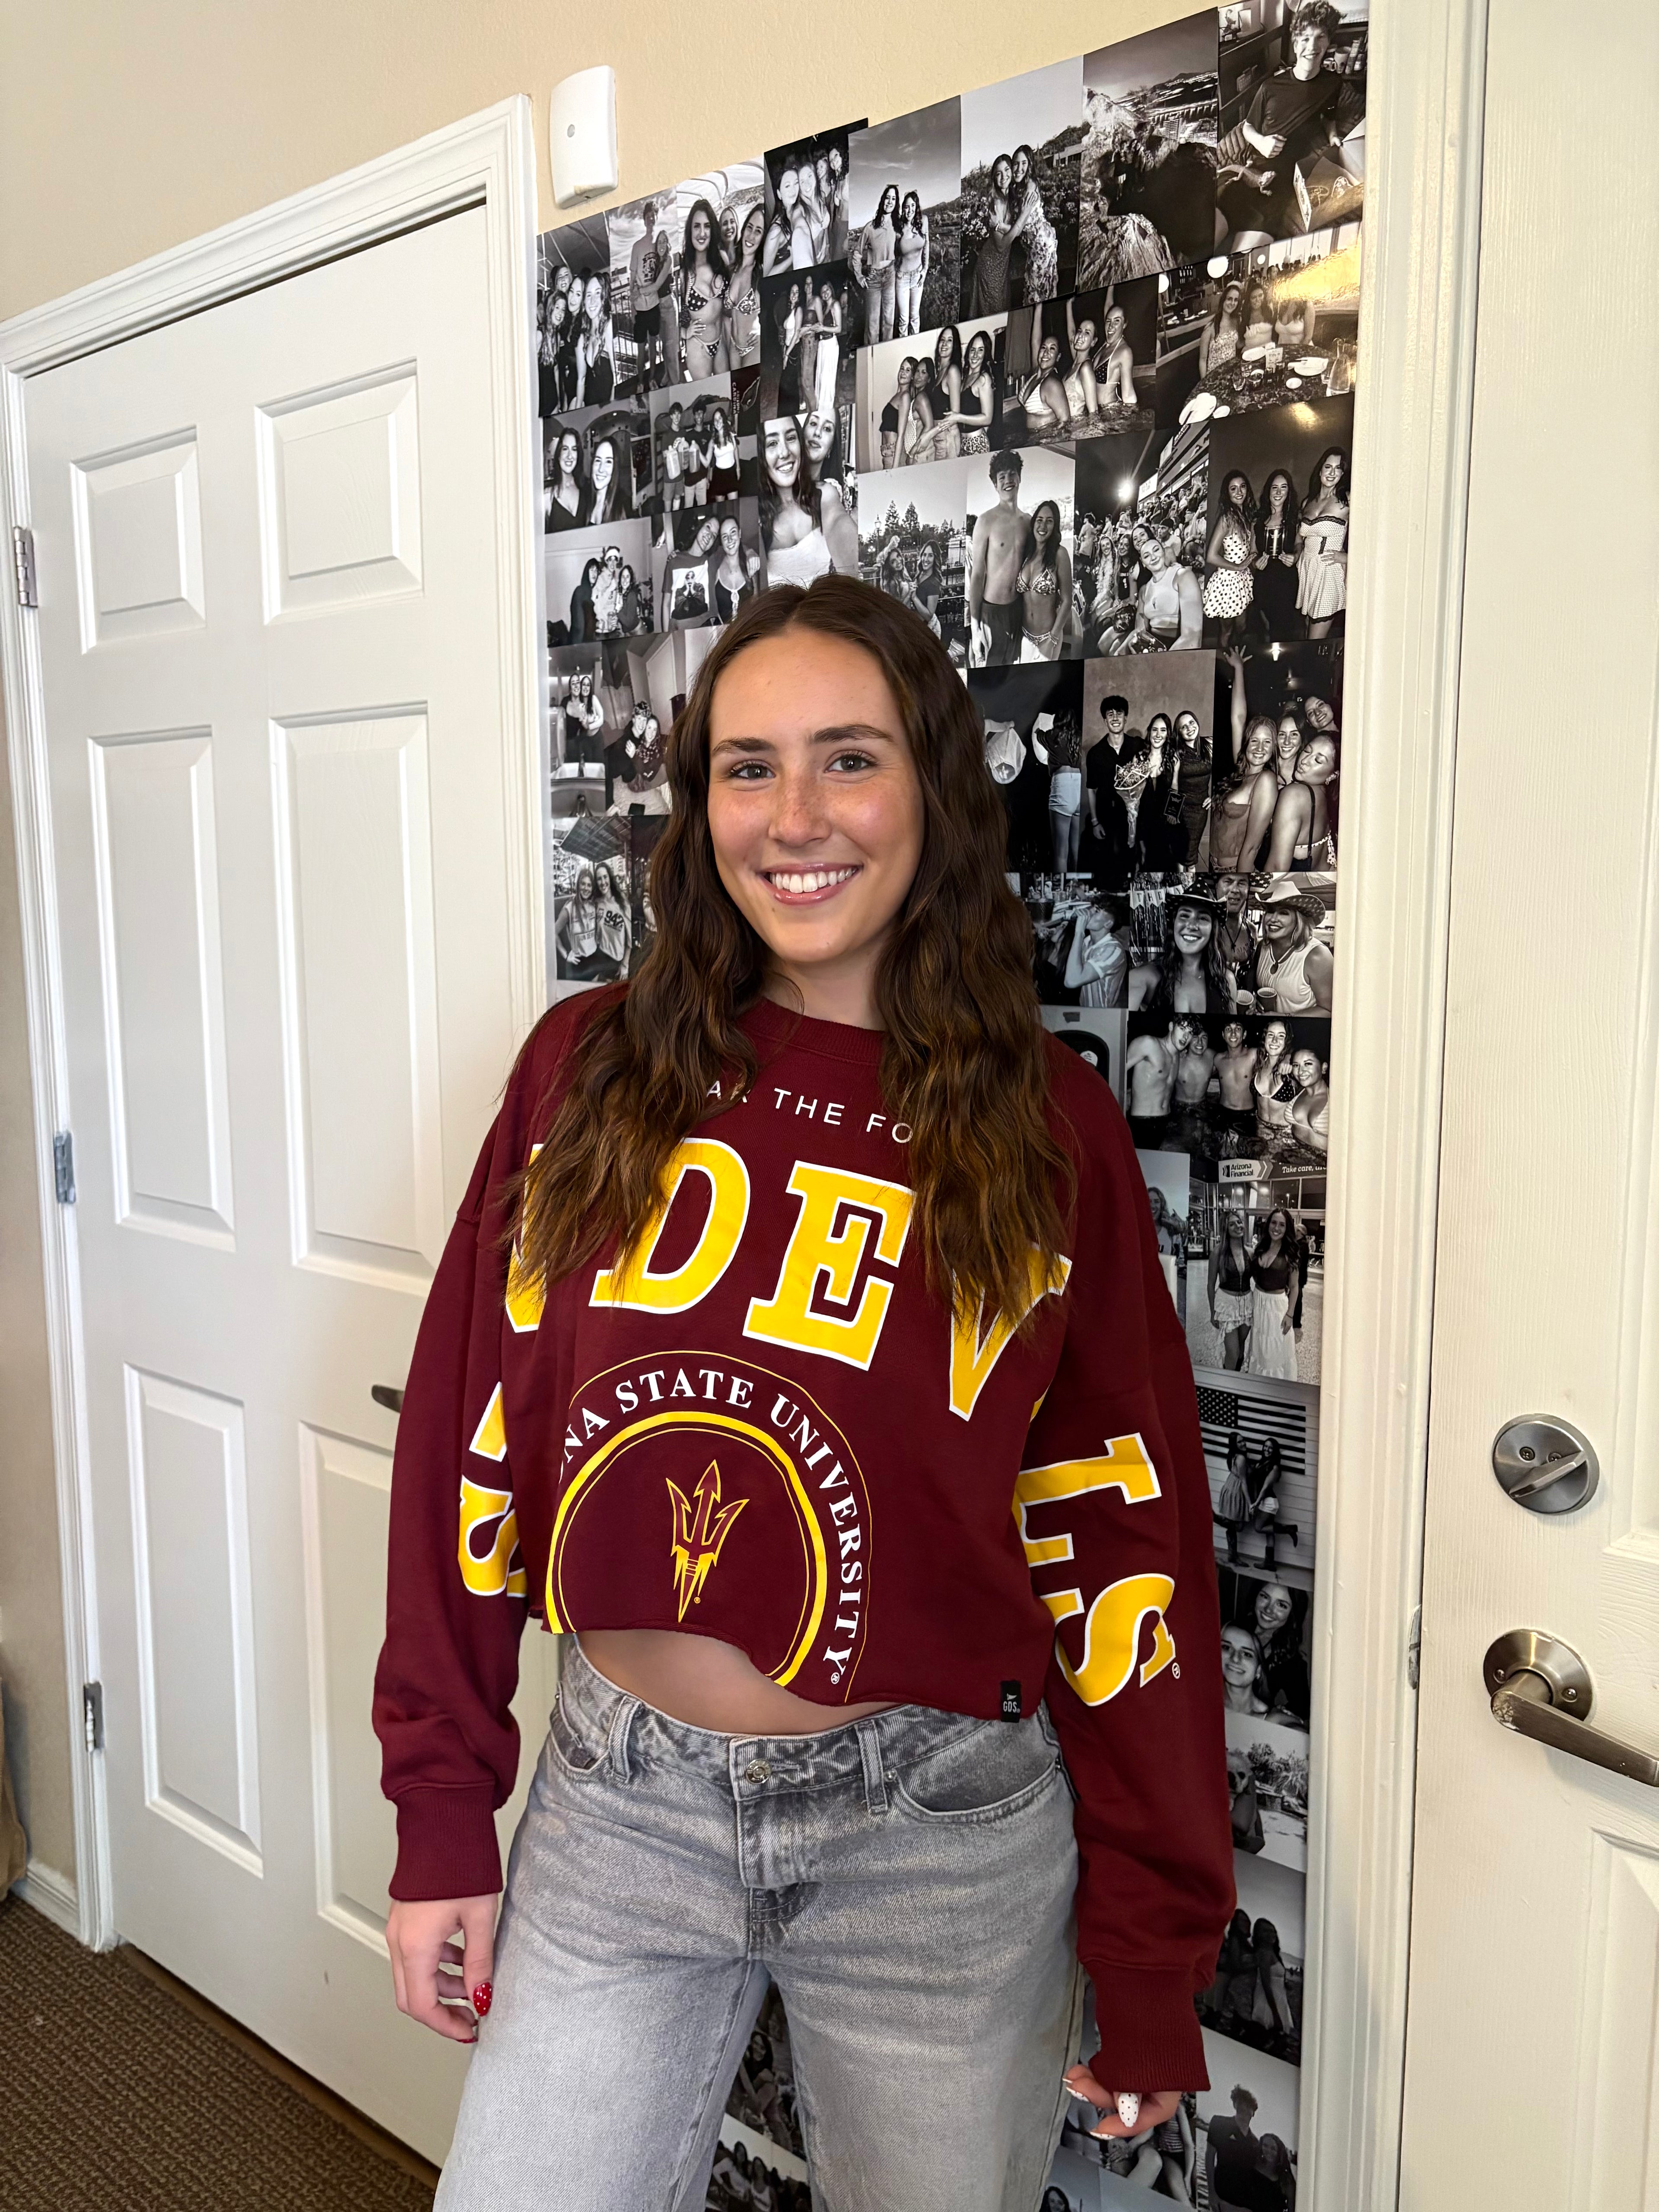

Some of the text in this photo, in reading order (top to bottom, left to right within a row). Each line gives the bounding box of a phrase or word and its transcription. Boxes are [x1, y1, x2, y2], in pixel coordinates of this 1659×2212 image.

[774, 1088, 845, 1125] THE
[866, 1114, 913, 1144] FO
[1231, 1169, 1254, 1177] Financial
[615, 1368, 754, 1414] STATE
